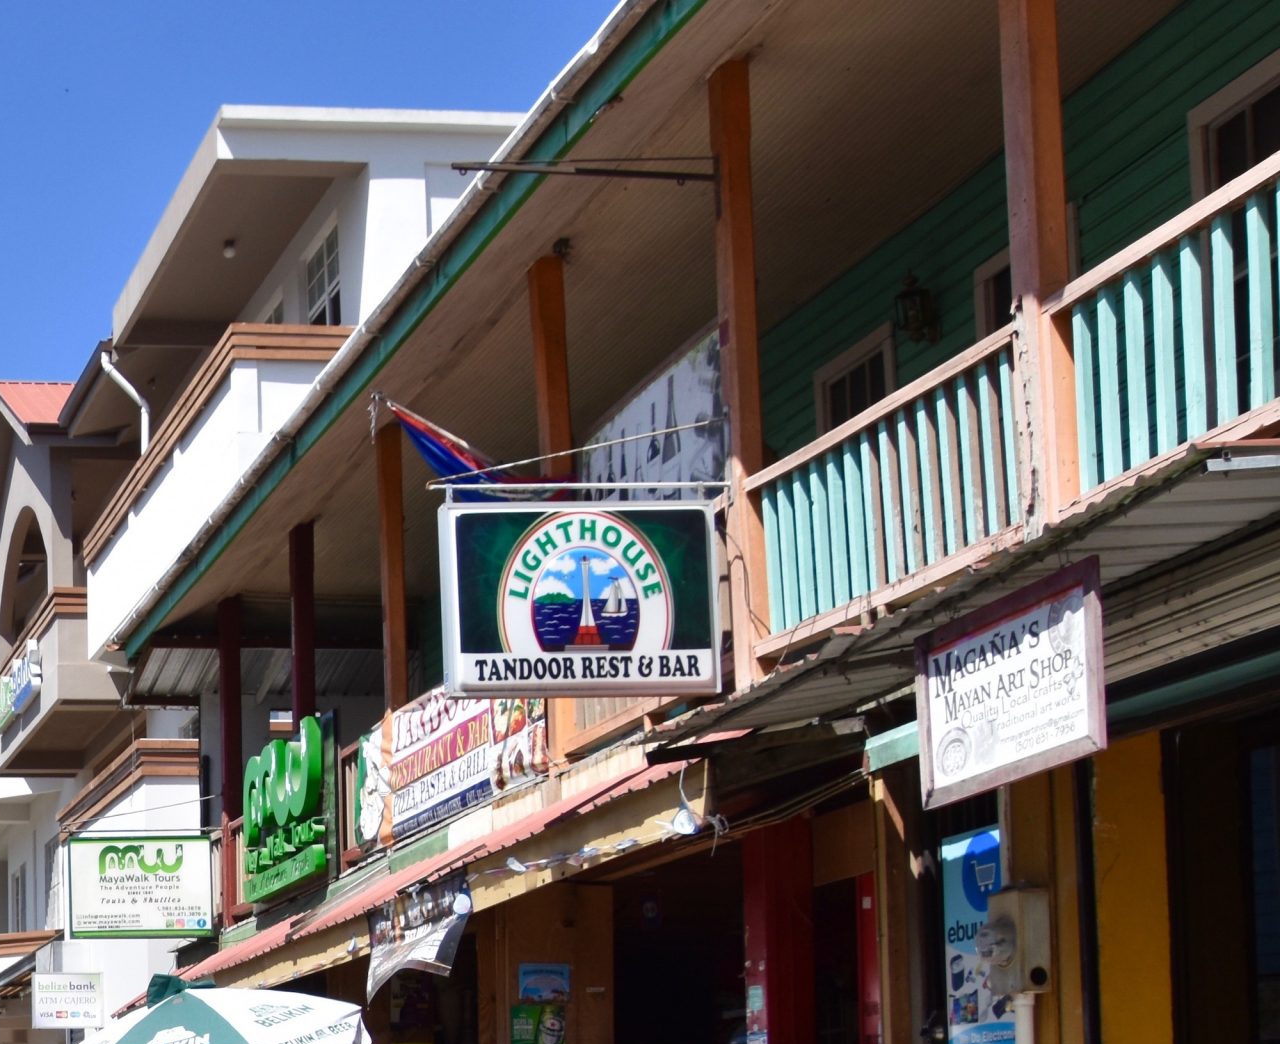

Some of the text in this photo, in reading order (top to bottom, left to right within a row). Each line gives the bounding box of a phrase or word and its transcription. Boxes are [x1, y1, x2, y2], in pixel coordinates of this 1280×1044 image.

[509, 518, 664, 602] LIGHTHOUSE
[475, 654, 702, 682] TANDOOR REST & BAR
[932, 620, 1041, 698] MAGAÑA'S
[944, 649, 1072, 725] MAYAN ART SHOP
[961, 676, 1063, 730] Quality Local crafts
[988, 691, 1081, 736] Traditional art works
[390, 712, 490, 790] RESTAURANT & BAR
[419, 771, 447, 804] PASTA
[457, 749, 489, 783] GRILL
[99, 873, 181, 884] MayaWalk Tours
[38, 996, 58, 1005] ATM
[64, 996, 97, 1005] CAJERO
[259, 1003, 316, 1029] BELIKIN
[328, 1021, 356, 1040] BEER
